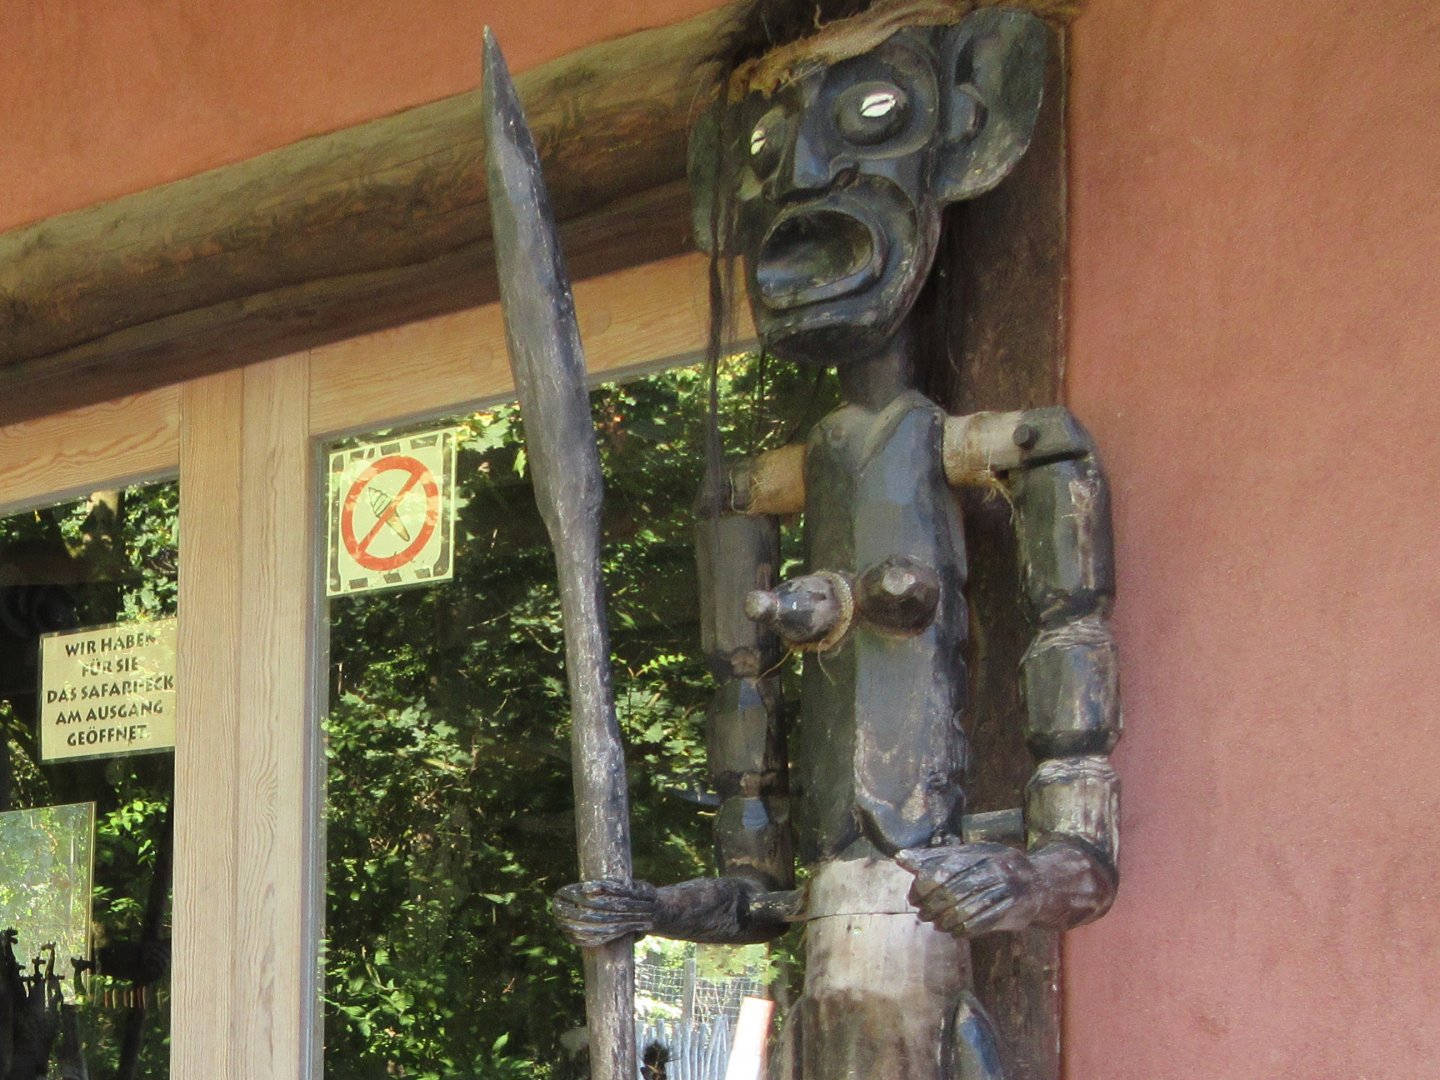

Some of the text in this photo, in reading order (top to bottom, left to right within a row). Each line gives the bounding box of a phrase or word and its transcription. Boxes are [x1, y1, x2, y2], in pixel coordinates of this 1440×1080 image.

[65, 632, 157, 657] WIR HABEN
[82, 657, 138, 677] FÜR SIE
[47, 675, 174, 704] DAS SAFARI-ECK
[55, 700, 163, 725] AM AUSGANG
